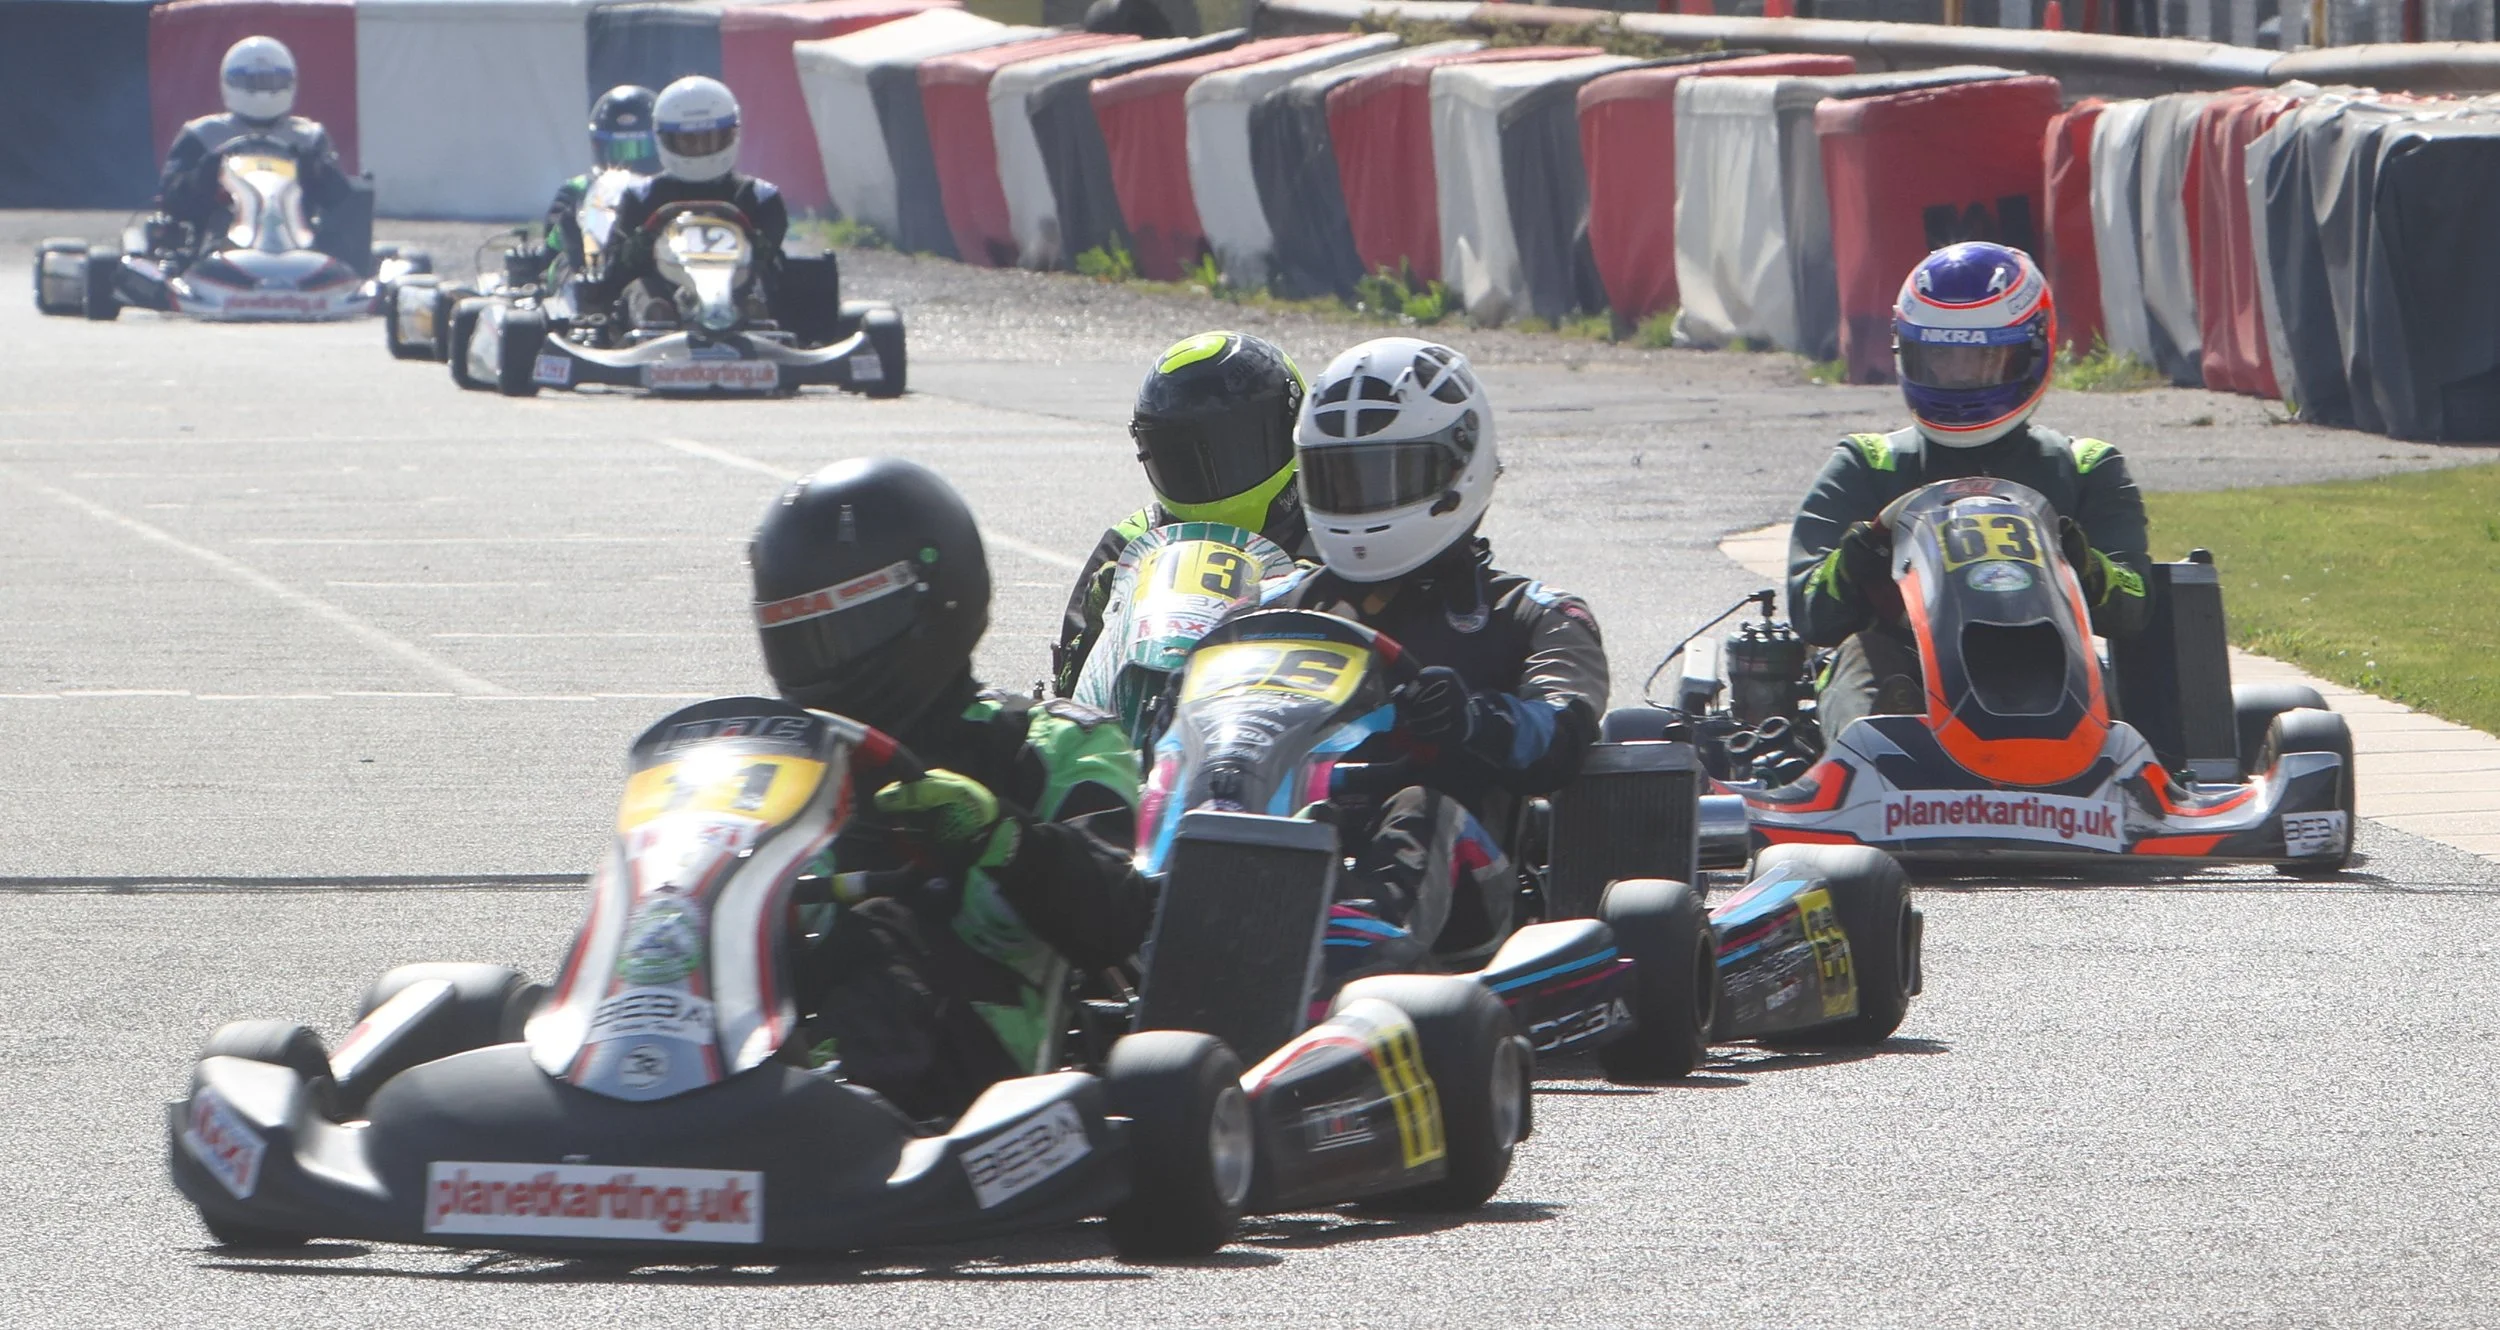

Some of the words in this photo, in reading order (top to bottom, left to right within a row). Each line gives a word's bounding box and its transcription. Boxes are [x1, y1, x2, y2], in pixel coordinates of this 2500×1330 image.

[680, 226, 738, 253] 12
[1943, 516, 2036, 562] 63
[1885, 794, 2118, 840] planetkarting.uk
[591, 993, 702, 1029] BEBA
[429, 1168, 753, 1233] planetkarting.uk
